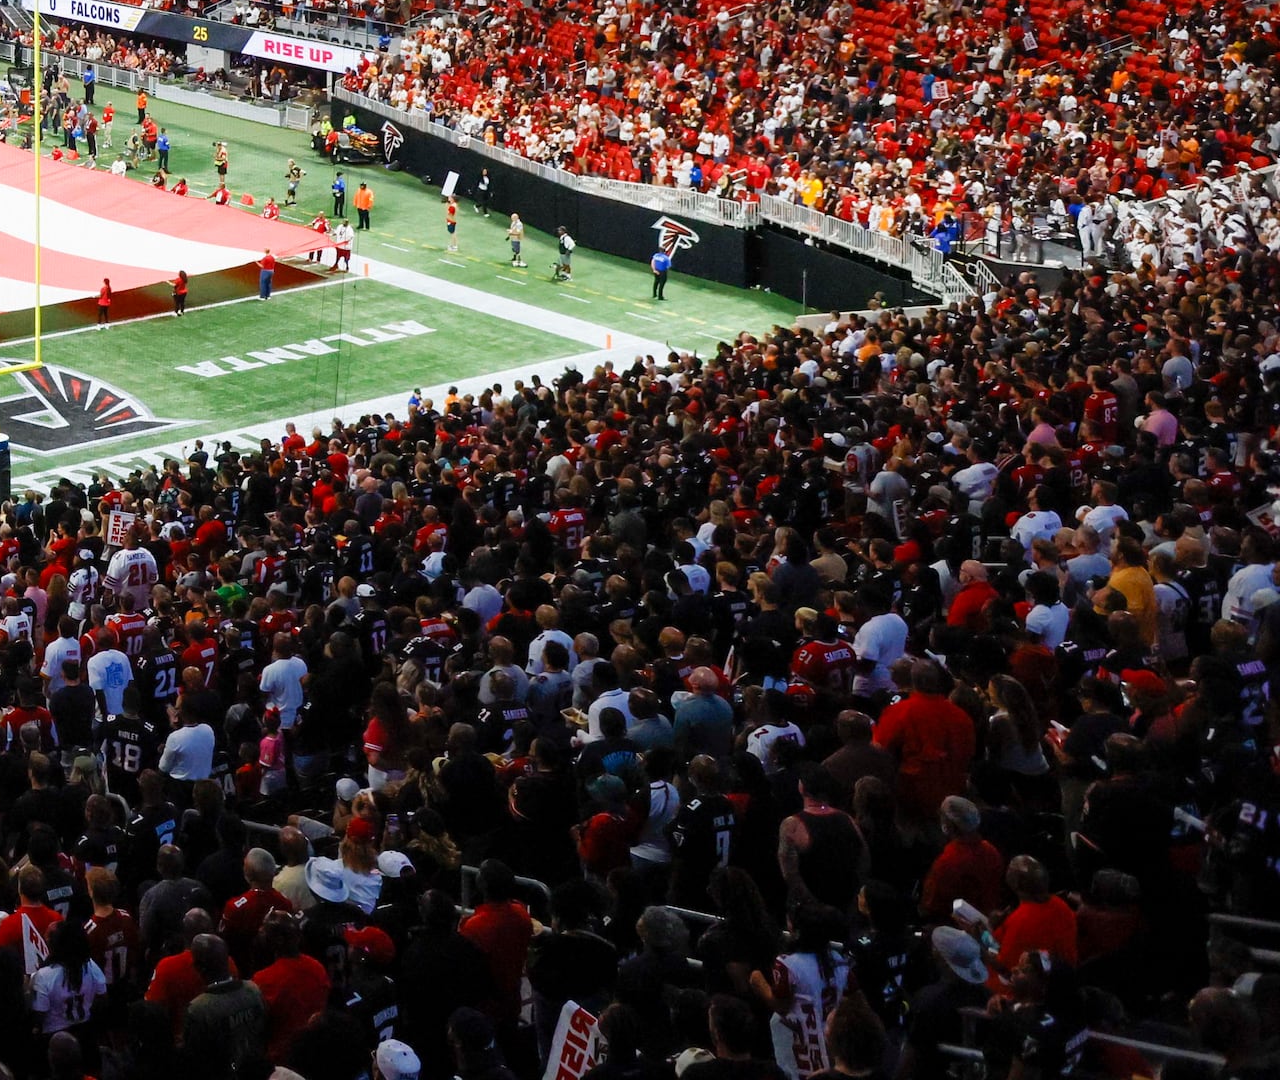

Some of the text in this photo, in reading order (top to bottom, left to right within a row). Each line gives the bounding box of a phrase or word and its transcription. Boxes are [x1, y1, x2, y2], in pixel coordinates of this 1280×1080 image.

[71, 1, 120, 24] FALCONS
[193, 26, 208, 41] 25
[264, 39, 333, 64] RISE UP
[174, 320, 438, 378] ATLANTA
[566, 526, 585, 550] 21
[360, 551, 373, 572] 11
[128, 564, 151, 586] 21
[127, 635, 143, 653] 10
[798, 650, 812, 665] 21
[824, 648, 851, 662] SANDERS
[154, 668, 176, 698] 21
[204, 660, 215, 687] 7
[478, 708, 491, 723] 21
[503, 708, 528, 720] SANDERS
[112, 740, 142, 773] 18
[687, 798, 702, 811] 9
[1239, 802, 1268, 830] 21
[345, 992, 363, 1007] 7
